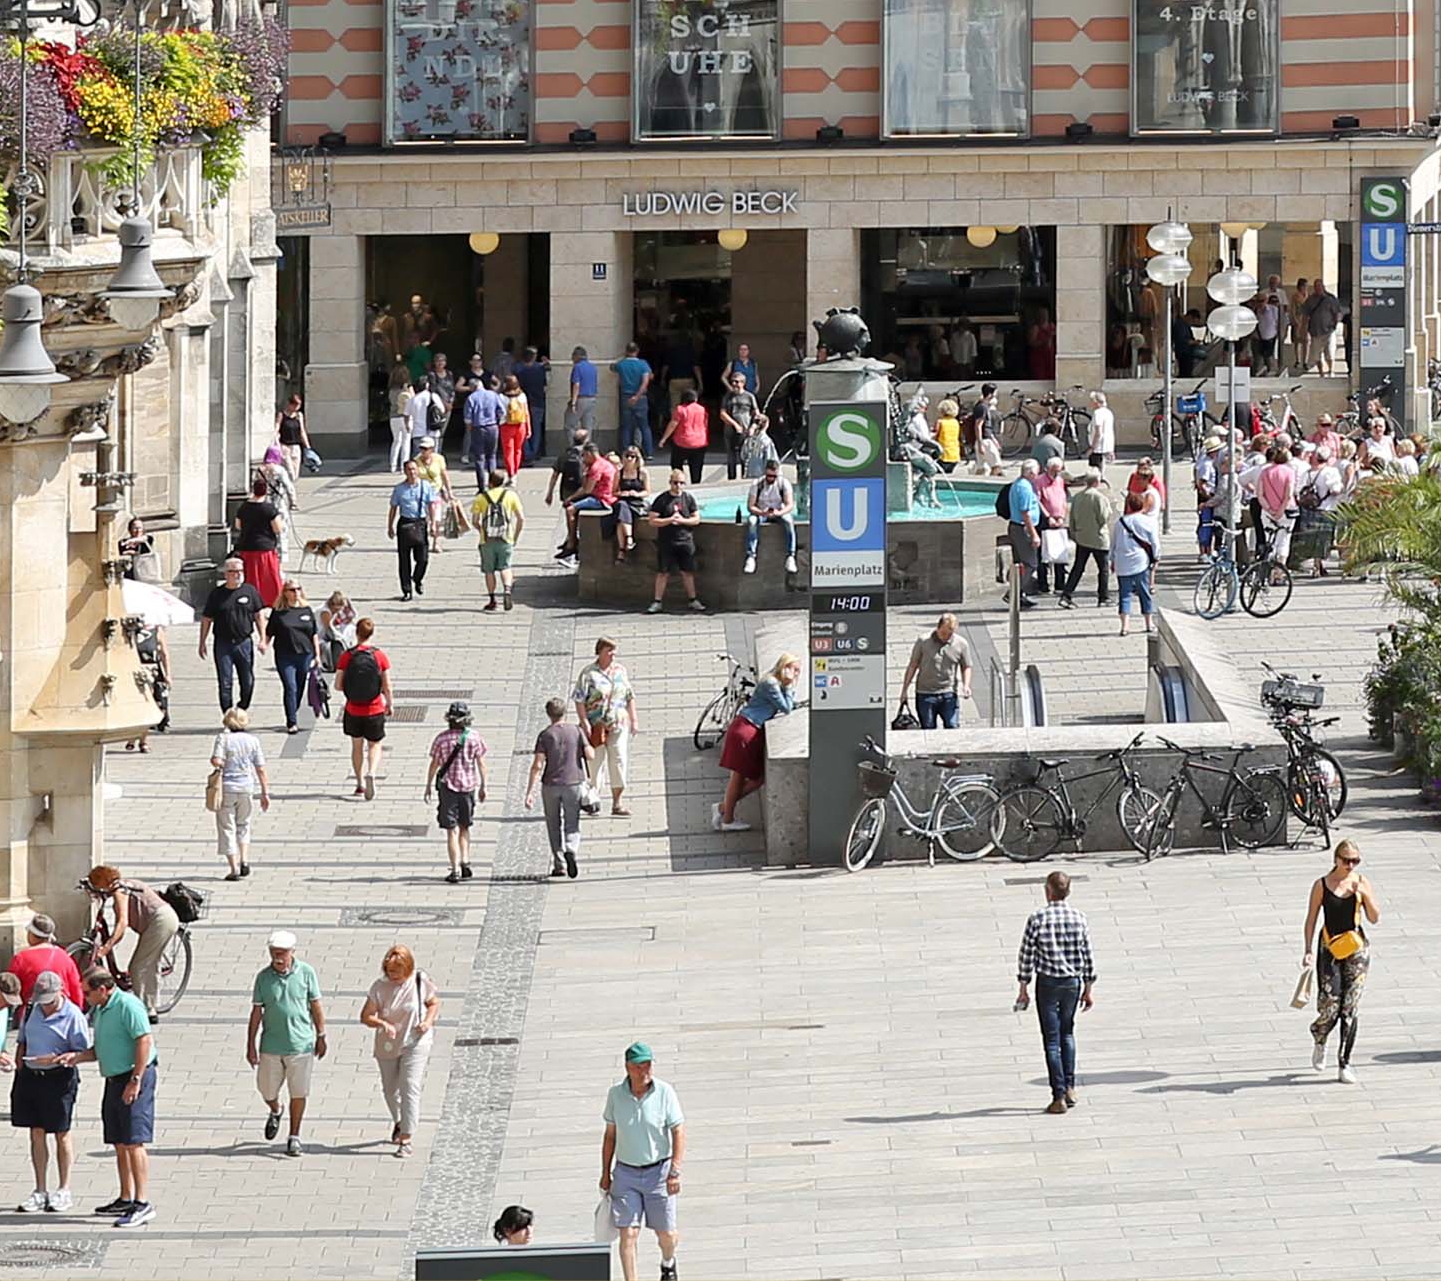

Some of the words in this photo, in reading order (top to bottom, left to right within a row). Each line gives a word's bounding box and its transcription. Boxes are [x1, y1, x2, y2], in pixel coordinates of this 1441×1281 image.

[1159, 6, 1181, 22] 4.
[670, 15, 751, 38] SCH
[668, 50, 753, 74] UHE
[623, 192, 725, 216] LUDWIG
[731, 191, 798, 214] BECK
[1370, 184, 1397, 217] S
[1370, 228, 1395, 261] U
[827, 413, 872, 468] S
[826, 487, 868, 541] U
[814, 564, 883, 578] Marienplatz
[831, 596, 871, 610] 14:00
[815, 640, 829, 649] U3
[837, 640, 852, 649] U6
